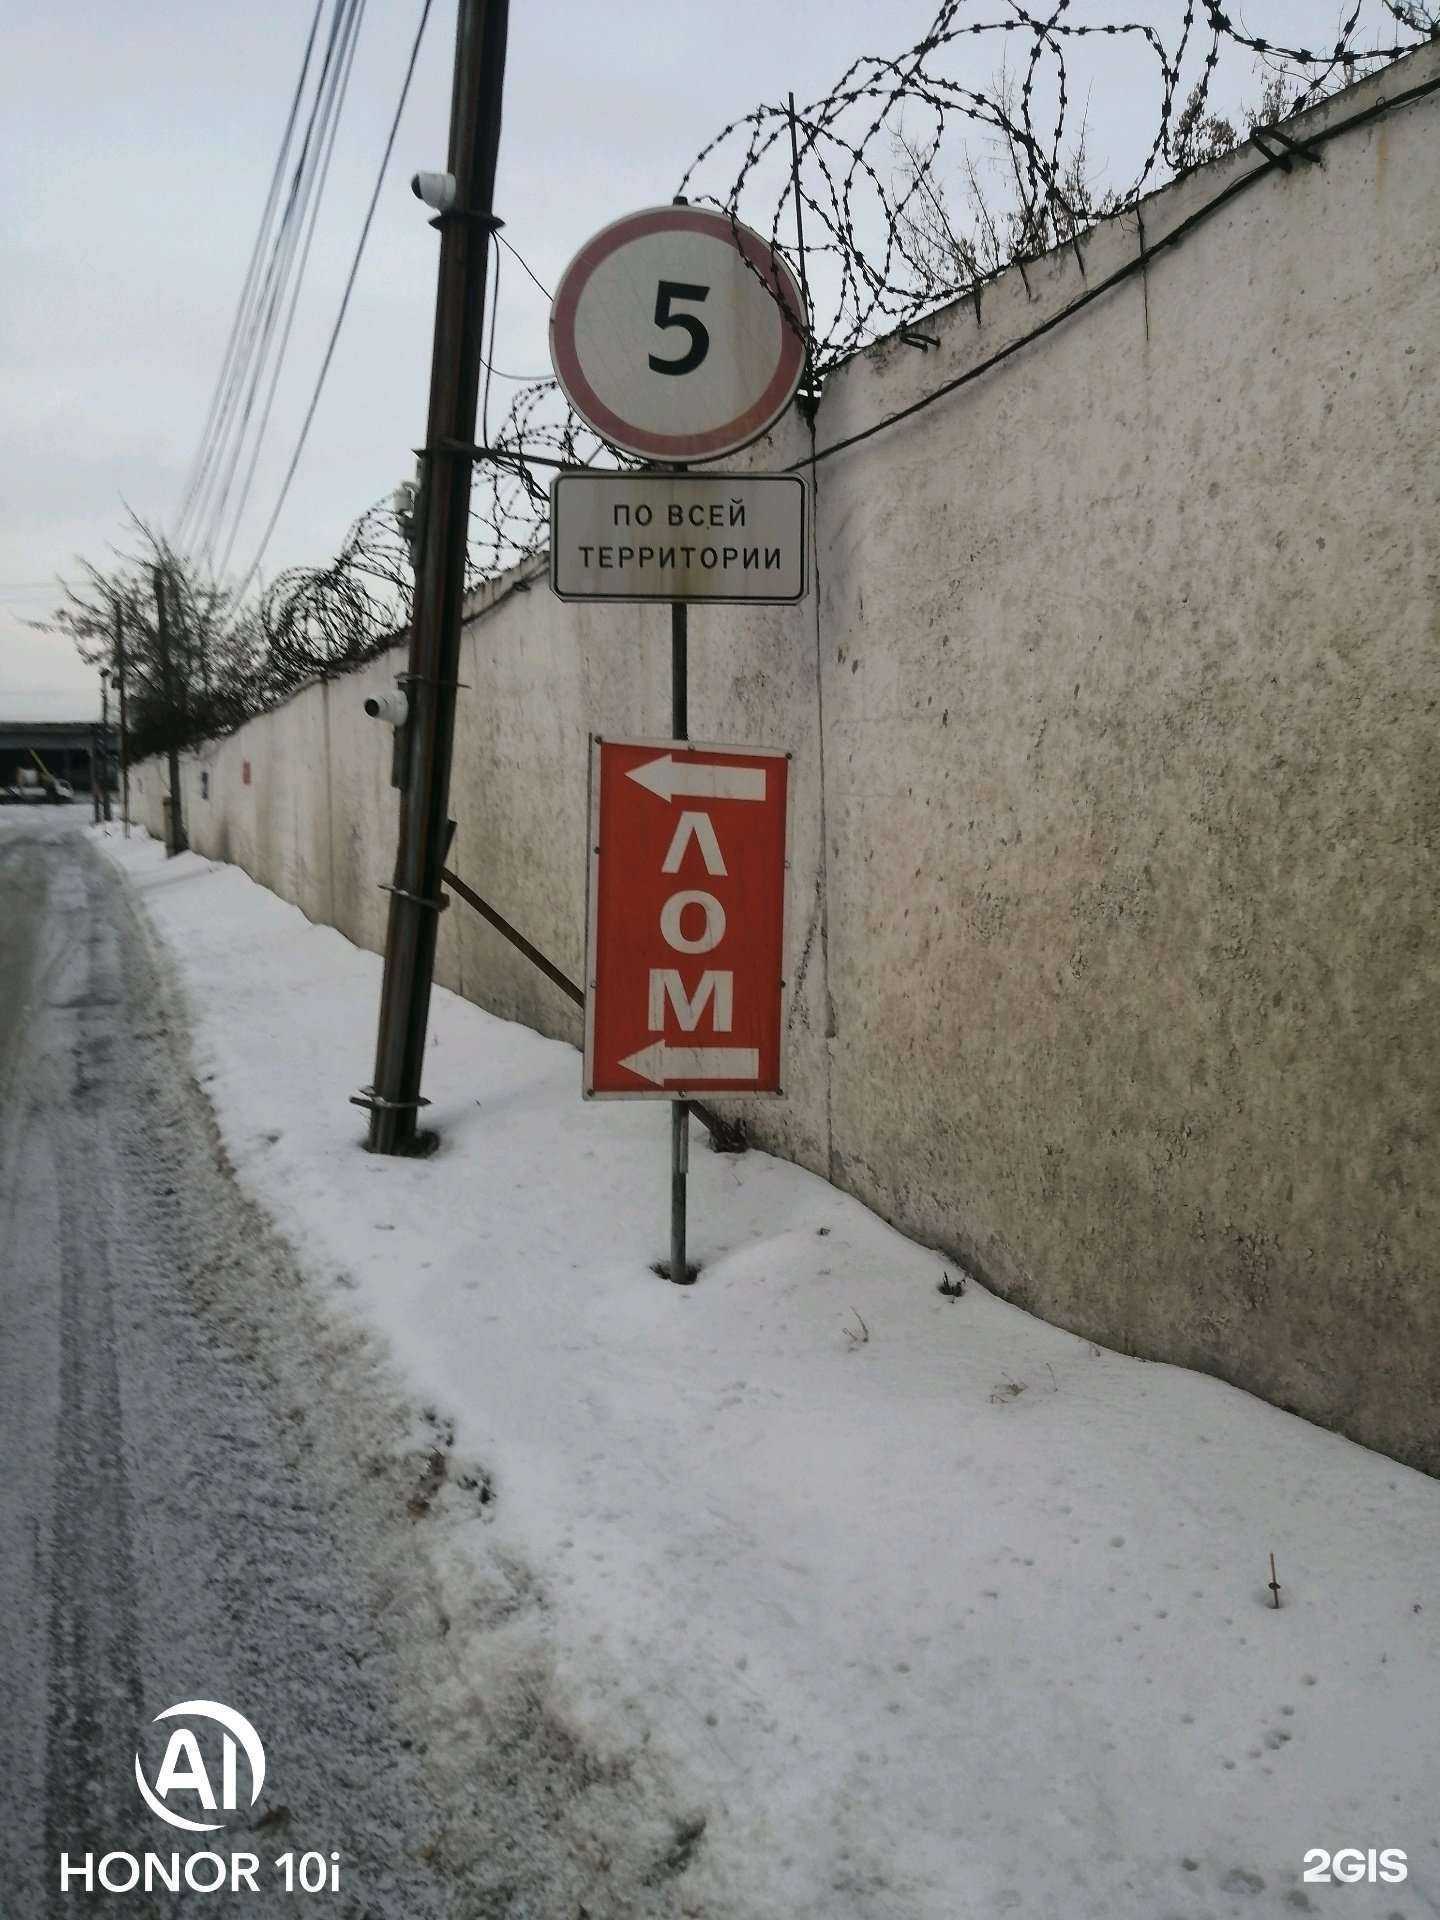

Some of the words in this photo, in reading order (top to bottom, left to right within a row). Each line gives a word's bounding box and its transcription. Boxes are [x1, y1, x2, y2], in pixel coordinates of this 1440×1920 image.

[648, 279, 711, 377] 5
[613, 504, 654, 528] ПО
[668, 498, 746, 528] ВСЕЙ
[578, 545, 782, 571] ТЕРРИТОРИИ
[647, 810, 734, 1033] ЛОМ
